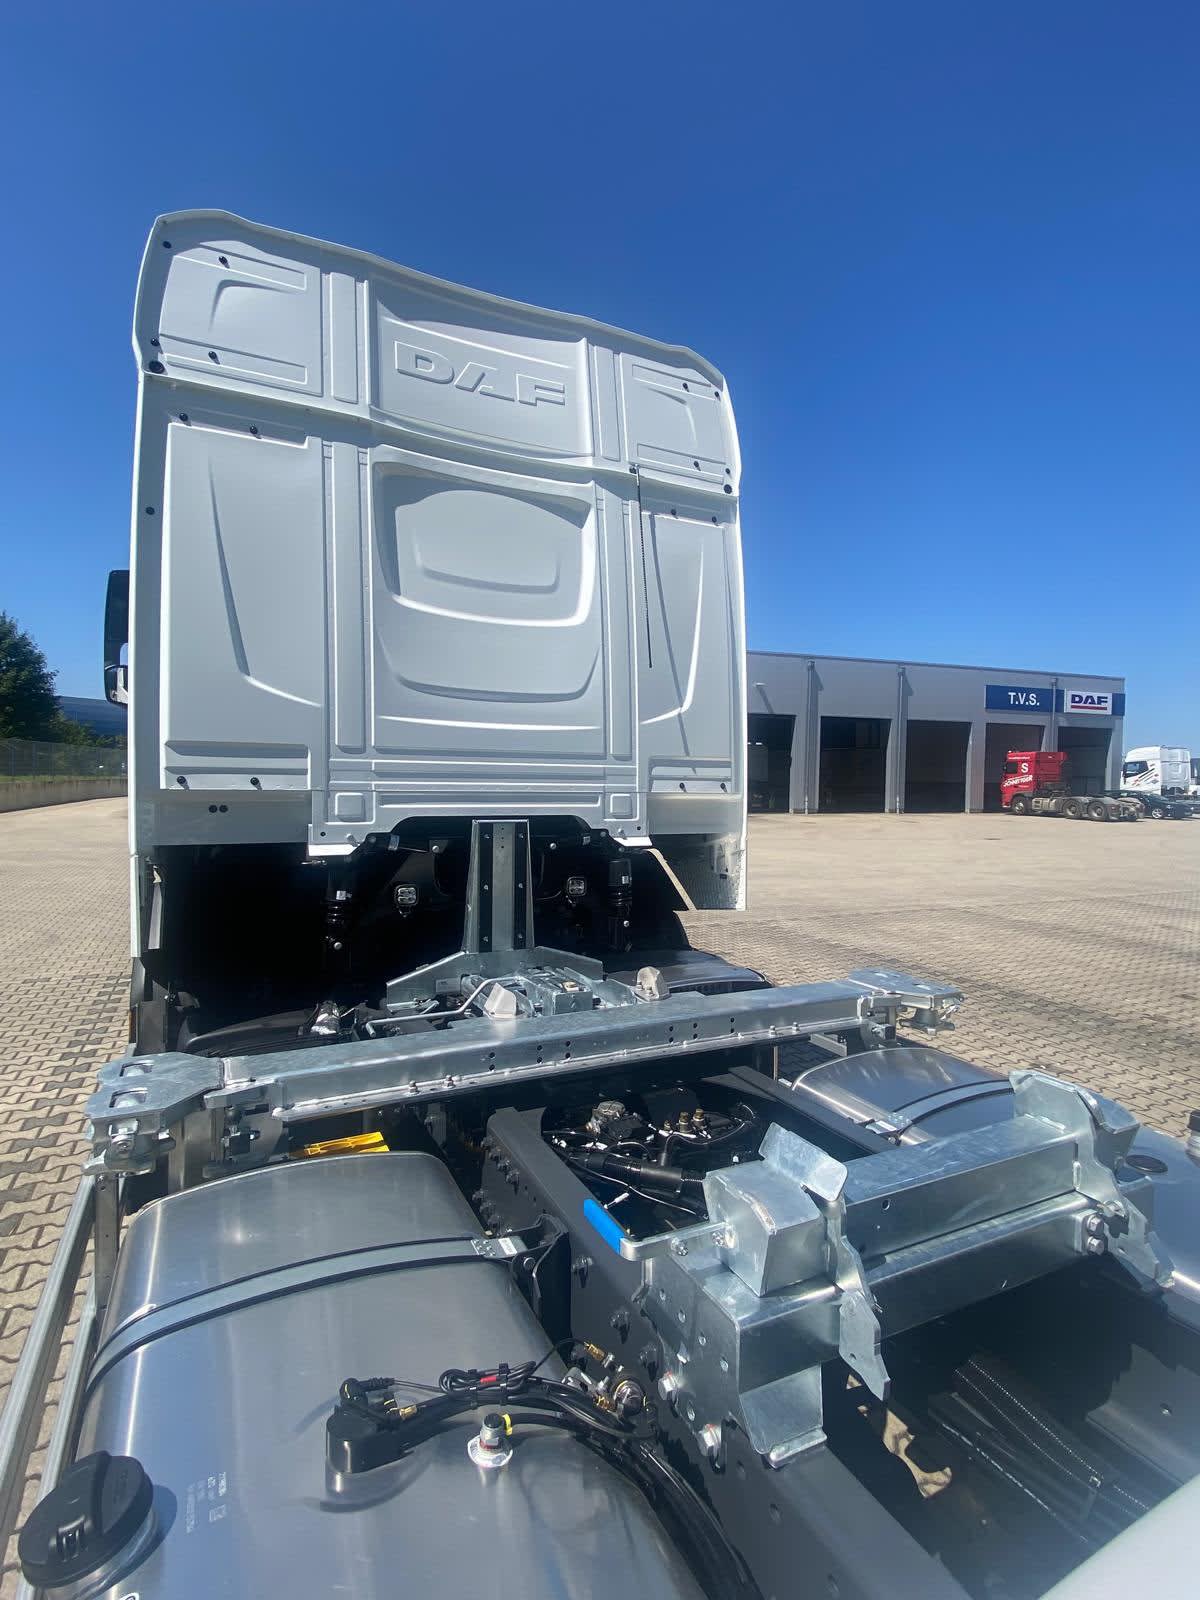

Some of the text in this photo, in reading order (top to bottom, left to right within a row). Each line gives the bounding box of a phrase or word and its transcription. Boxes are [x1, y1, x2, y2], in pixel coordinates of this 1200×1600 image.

[393, 340, 566, 406] DAF
[1008, 692, 1040, 706] T.V.S.
[1071, 694, 1108, 705] DAF
[1021, 762, 1029, 773] S
